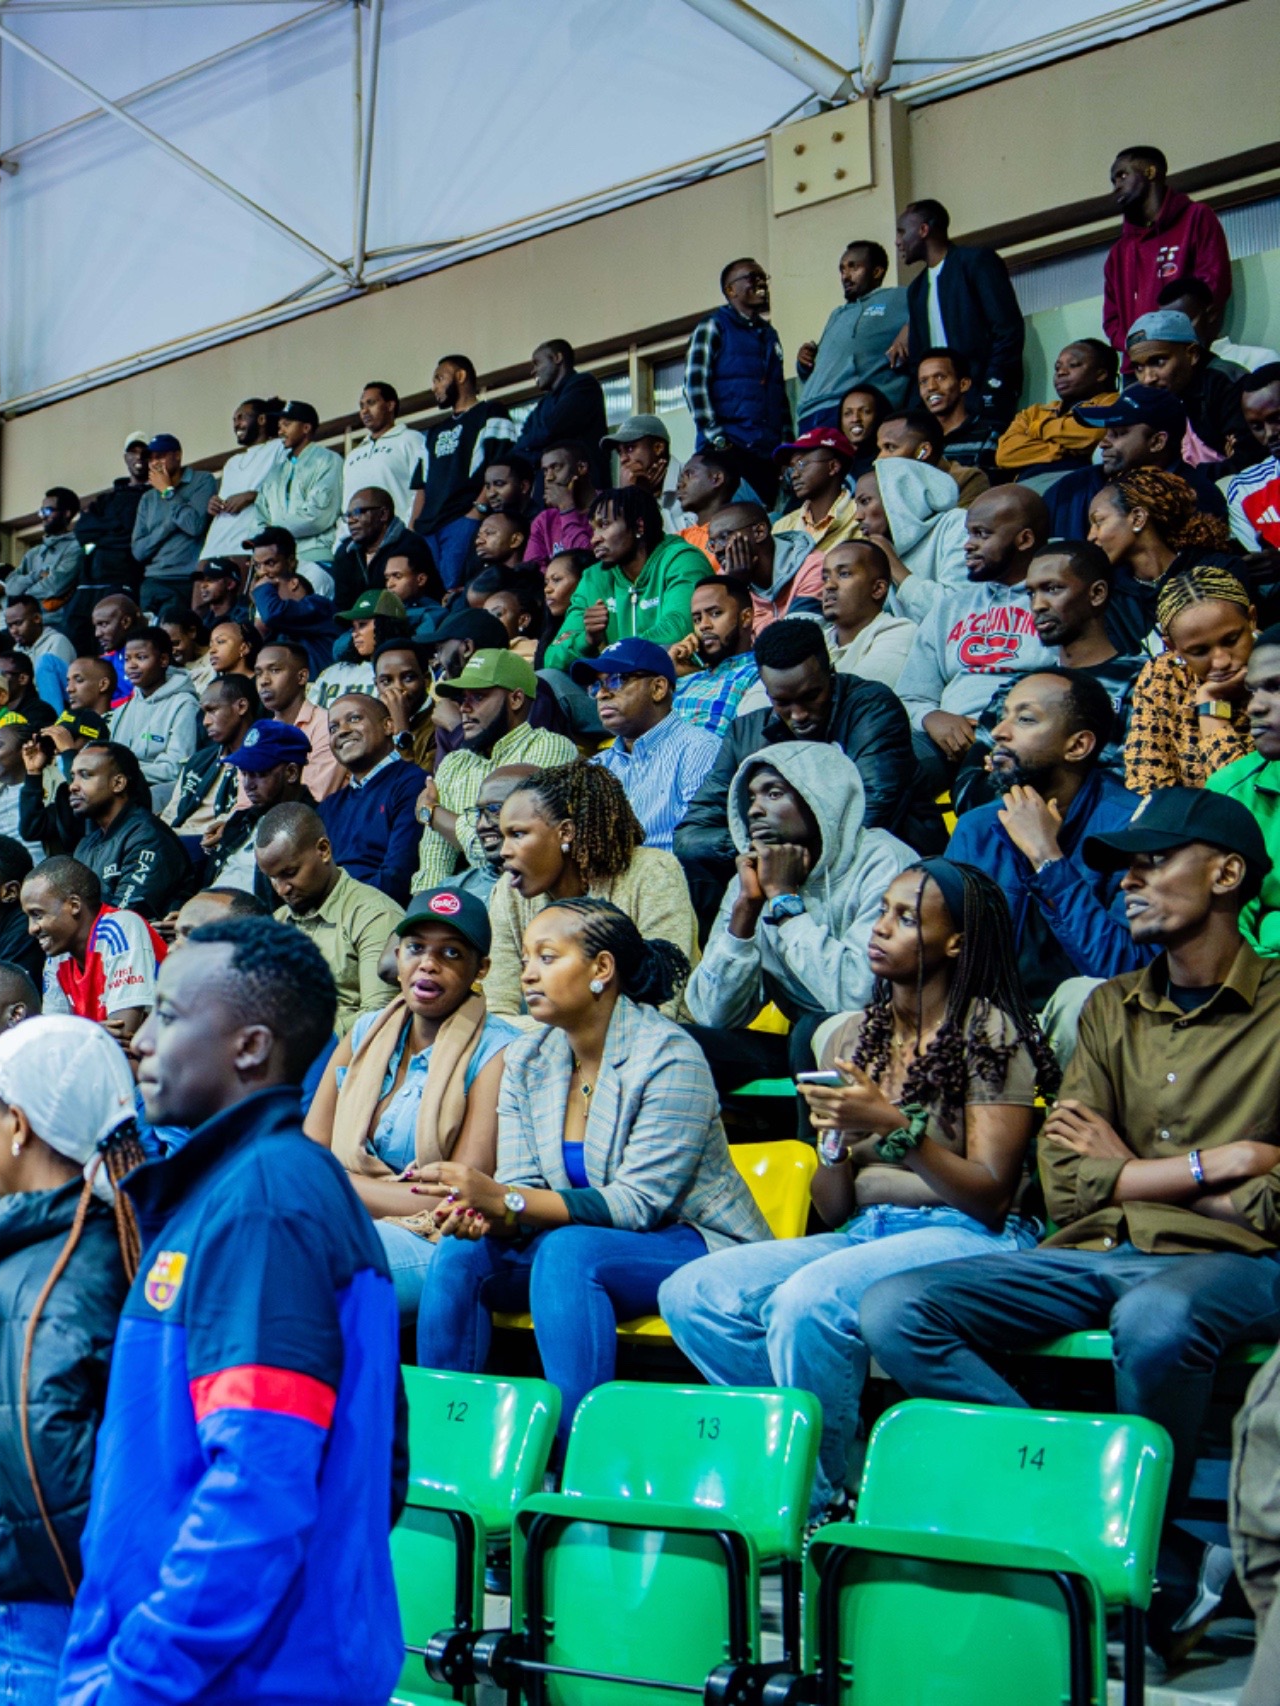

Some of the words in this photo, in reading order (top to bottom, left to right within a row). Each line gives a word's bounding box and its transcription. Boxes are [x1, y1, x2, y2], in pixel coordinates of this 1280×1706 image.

[947, 607, 1037, 643] ACCOUNTIN
[131, 850, 156, 885] EA7
[447, 1401, 469, 1422] 12
[697, 1417, 721, 1440] 13
[1018, 1445, 1045, 1471] 14
